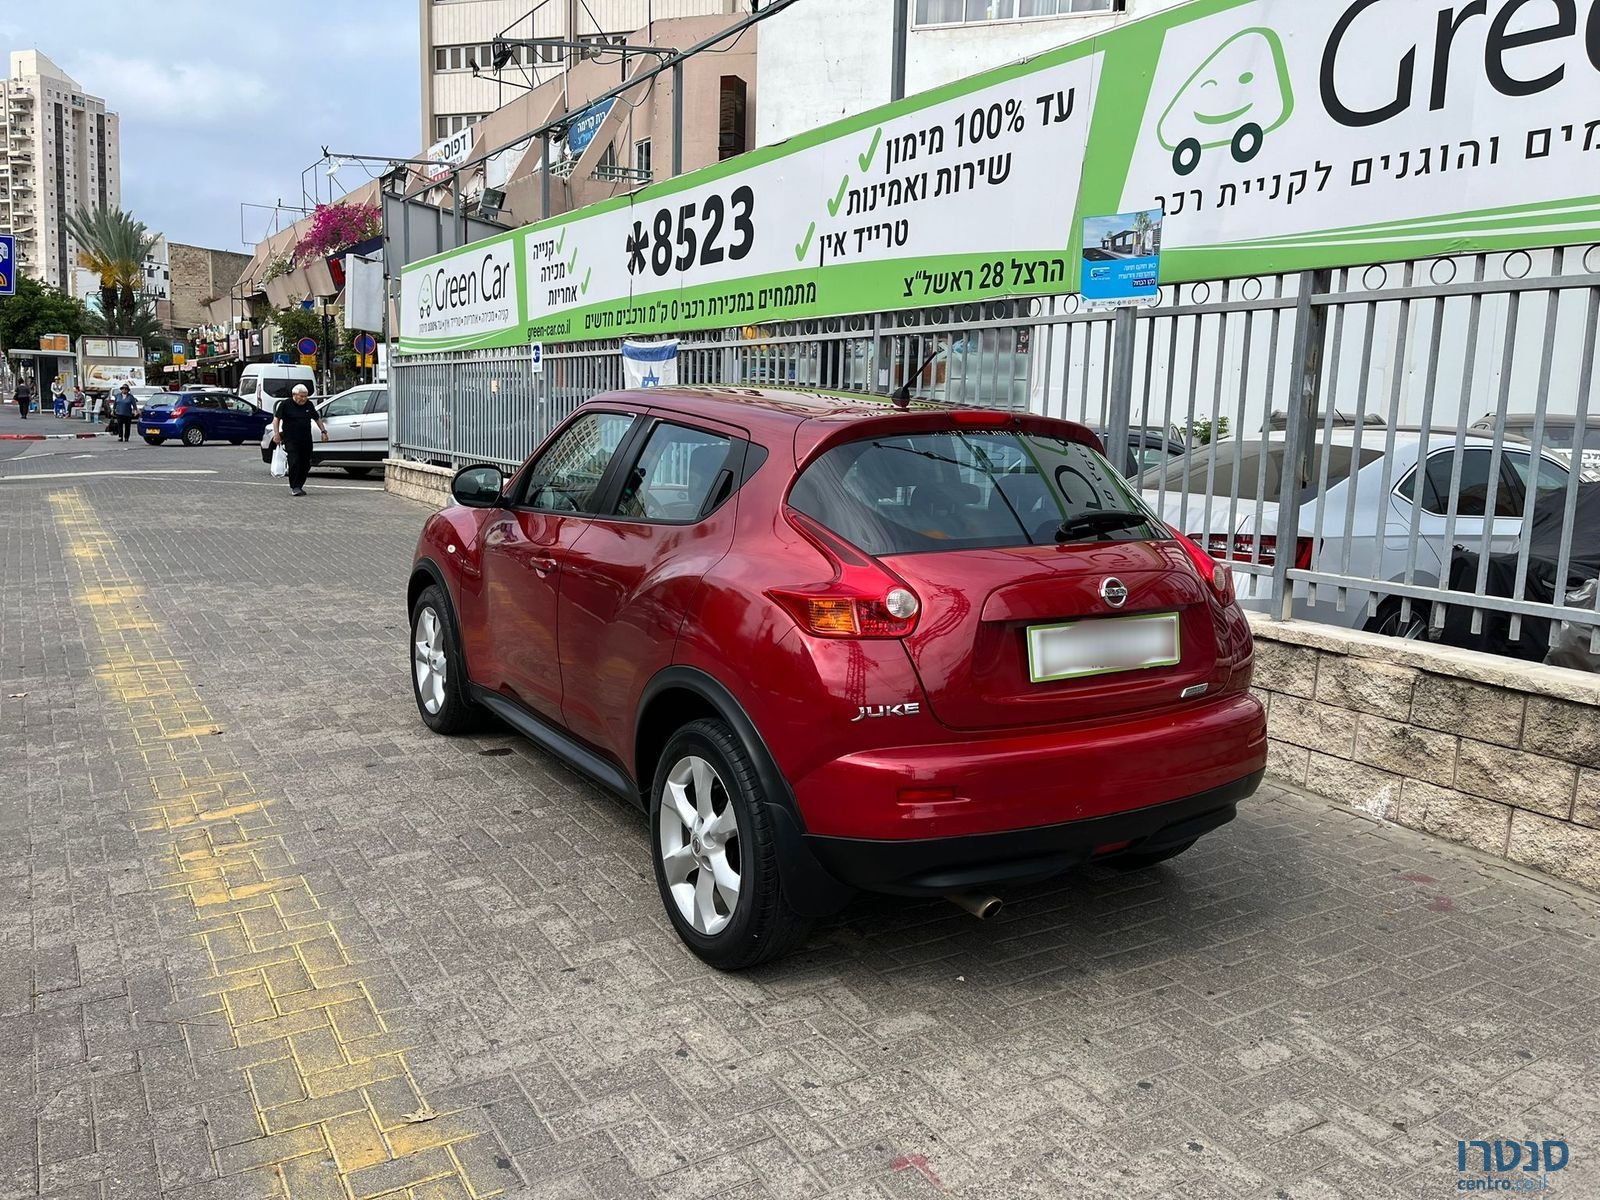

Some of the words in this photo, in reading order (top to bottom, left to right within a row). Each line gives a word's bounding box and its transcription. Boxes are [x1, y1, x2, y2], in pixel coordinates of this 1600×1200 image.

[1320, 0, 1600, 127] Gre
[1037, 88, 1074, 125] עד
[955, 99, 1025, 147] 100%
[444, 133, 467, 160] דפוס
[886, 126, 944, 174] מימון
[935, 153, 1012, 197] שירות
[1350, 136, 1499, 186] והוגנים
[846, 172, 928, 216] ואמינות
[1216, 160, 1332, 208] לקניית
[1154, 190, 1202, 216] רכב
[533, 239, 554, 260] קנייה
[819, 232, 847, 267] אין
[854, 220, 909, 253] טרייד
[435, 268, 476, 310] Green
[481, 254, 509, 301] Car
[540, 263, 565, 283] מכירה
[979, 261, 1005, 289] 28
[1011, 258, 1065, 286] הרצל
[547, 286, 578, 306] אחריות
[707, 291, 754, 316] במכירת
[758, 281, 817, 309] מתמחים
[585, 312, 614, 330] חדשים
[616, 307, 646, 326] ורכבים
[671, 299, 678, 321] 0
[680, 299, 705, 320] רכבי
[527, 321, 571, 341] green-car.co.il
[850, 702, 920, 722] JUKE
